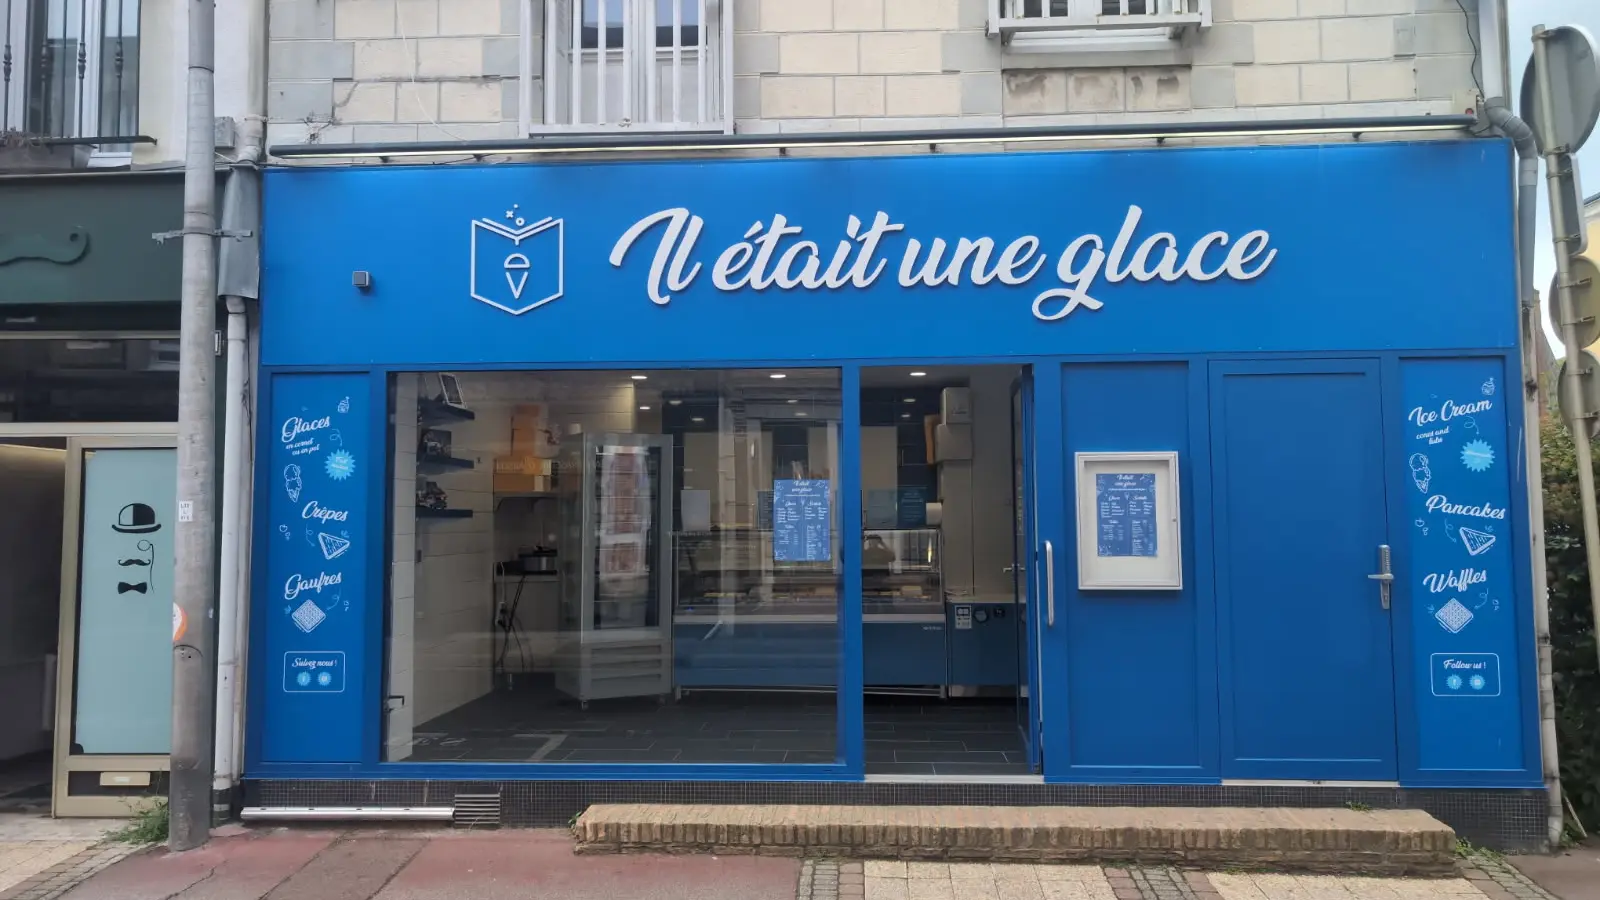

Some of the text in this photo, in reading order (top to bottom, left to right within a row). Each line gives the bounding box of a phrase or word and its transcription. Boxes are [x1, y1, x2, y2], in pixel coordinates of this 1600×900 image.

[609, 204, 1278, 321] Il était une glace
[1408, 399, 1493, 427] Ice Cream
[281, 416, 331, 443] Glaces
[1435, 425, 1450, 436] and
[301, 500, 349, 524] Crêpes
[1425, 494, 1506, 520] Pancakes
[284, 571, 342, 600] Gaufres
[1422, 567, 1487, 593] Waffles
[291, 657, 317, 670] Suivez
[316, 659, 333, 667] nous
[1443, 658, 1472, 670] Follow
